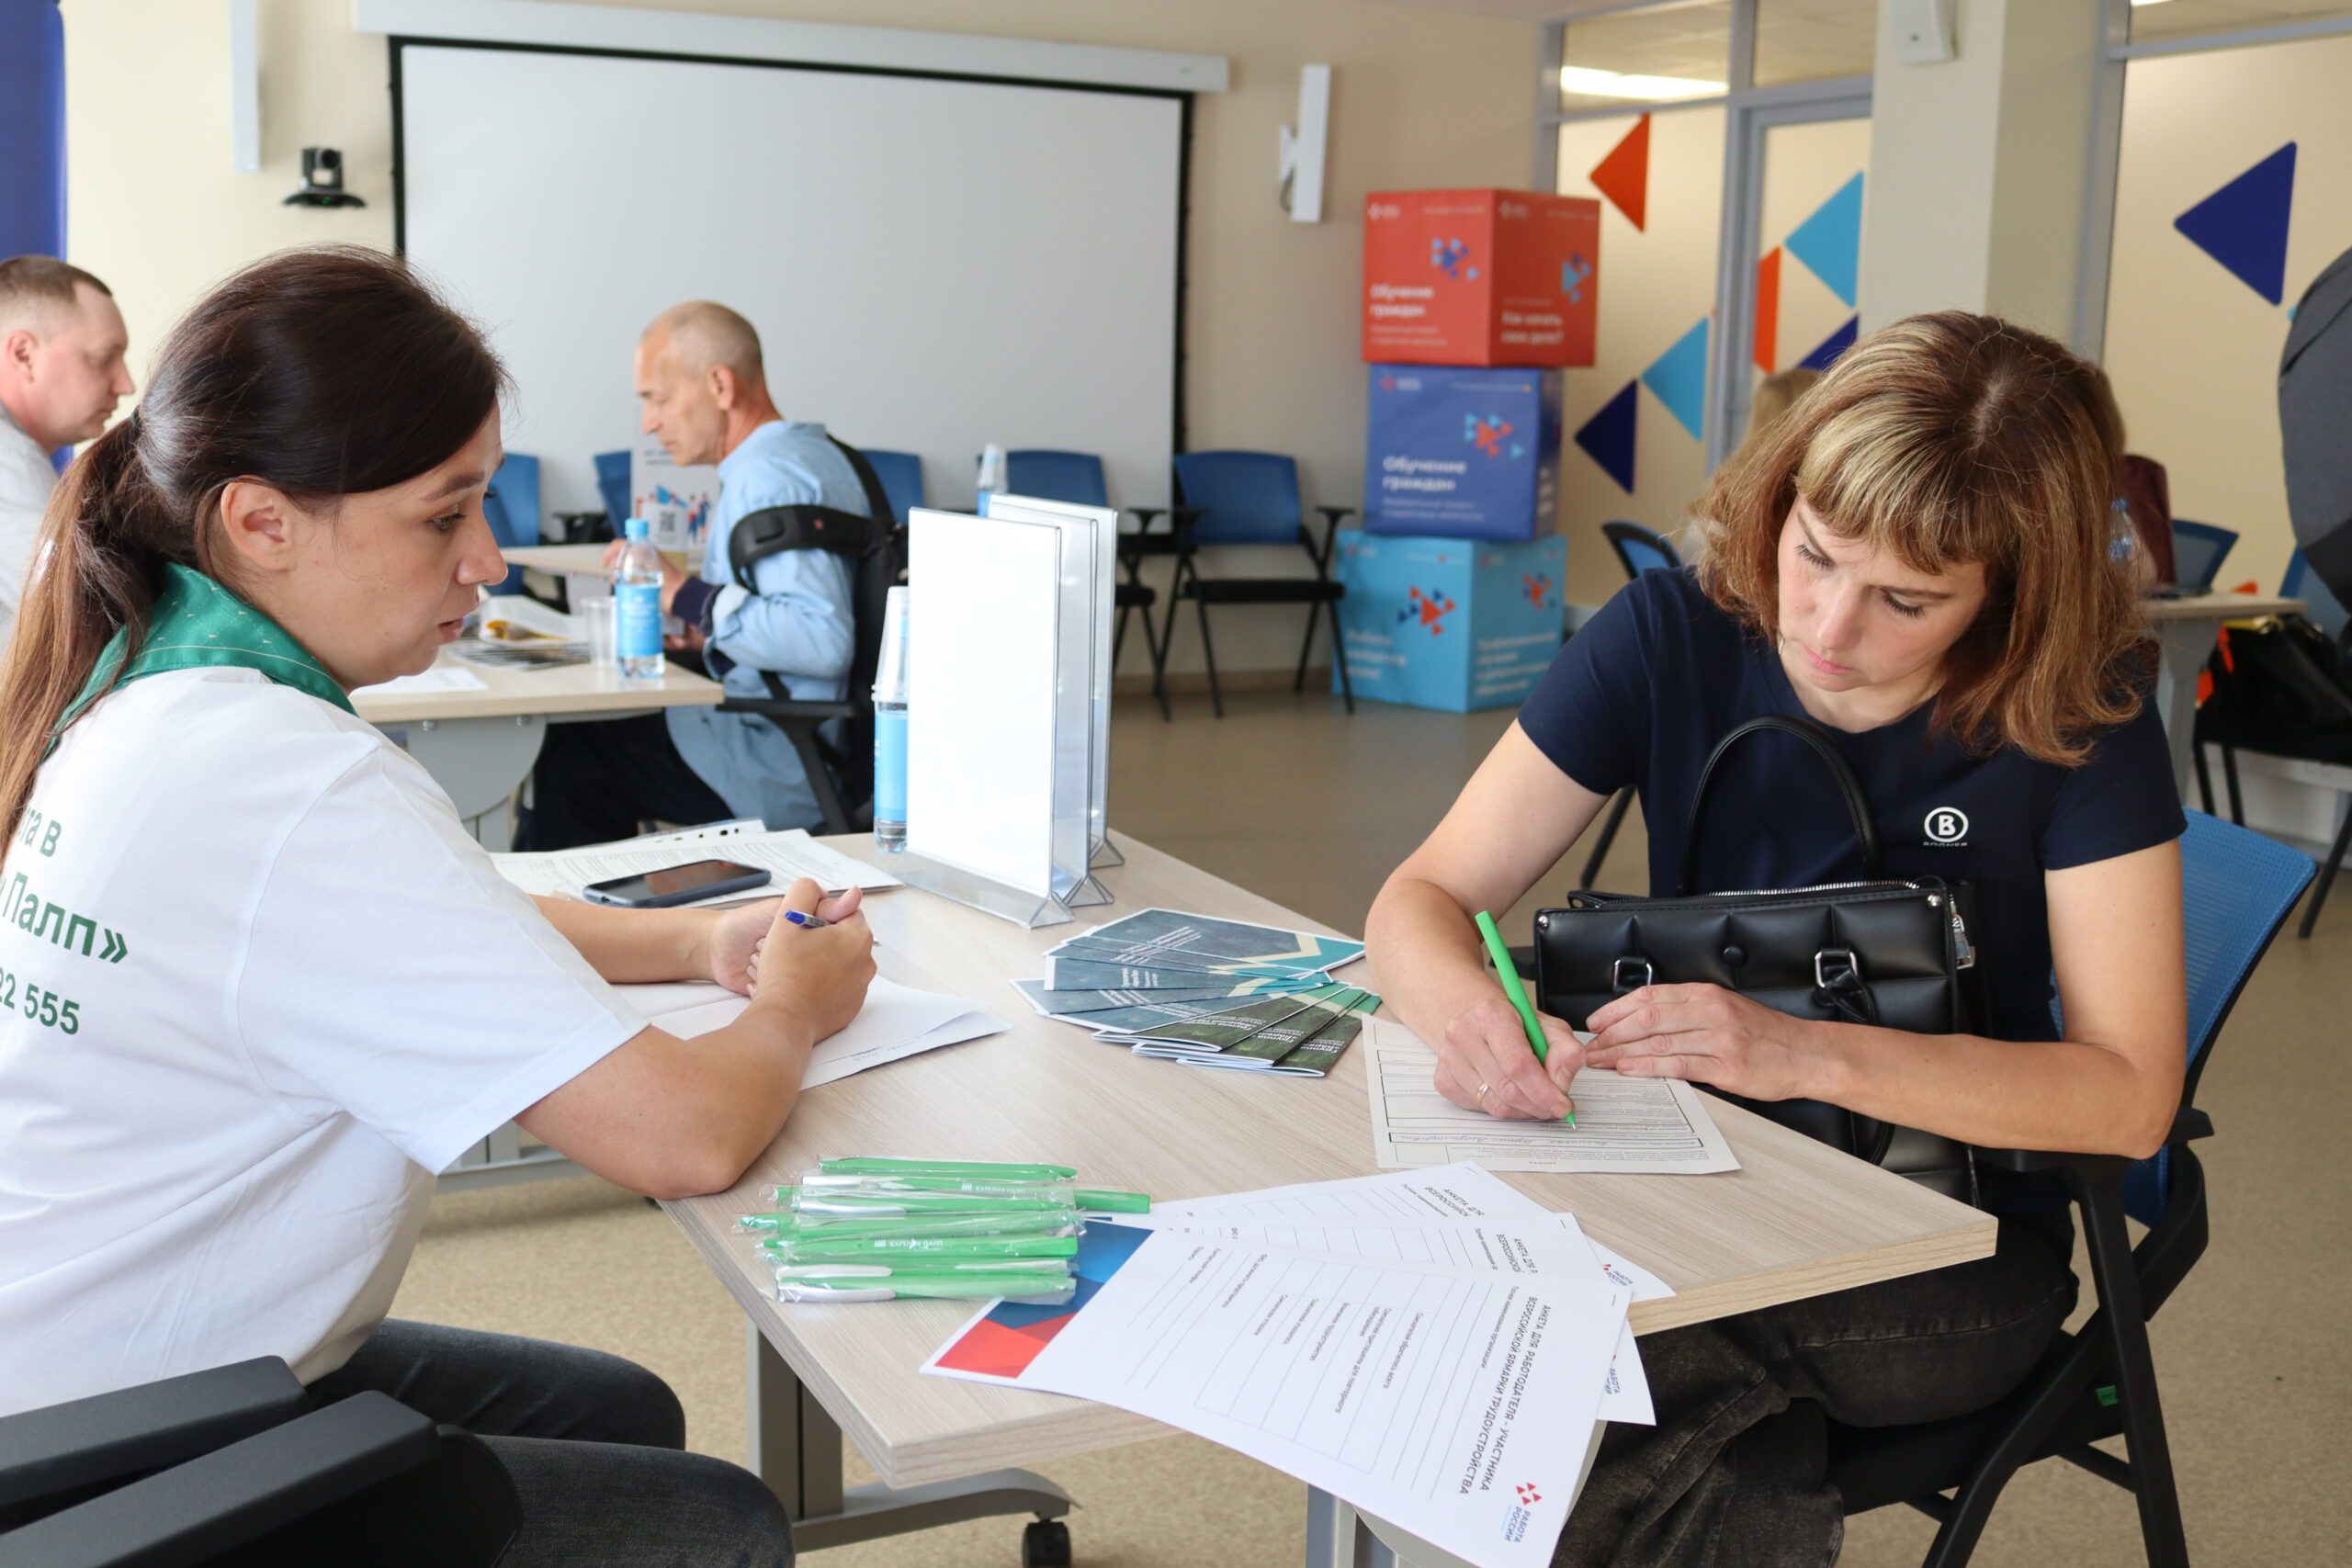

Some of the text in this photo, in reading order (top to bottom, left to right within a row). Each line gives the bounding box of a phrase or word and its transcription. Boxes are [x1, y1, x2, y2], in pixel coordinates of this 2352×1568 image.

[1383, 455, 1466, 475] Обучение
[1383, 476, 1455, 491] граждан
[2, 871, 128, 964] Палп»
[24, 983, 80, 1035] 555
[1442, 1190, 1469, 1210] АНКЕТА
[1513, 1238, 1529, 1257] АНКЕТА
[1494, 1300, 1510, 1333] наименование
[1535, 1304, 1551, 1332] АНКЕТА
[1480, 1333, 1498, 1369] организации
[1529, 1331, 1542, 1348] ДЛЯ
[1335, 1377, 1355, 1413] повторного
[1383, 1371, 1394, 1389] всего
[1459, 1296, 1538, 1494] ВСЕРОССИЙСКОЙ ЯРМАРКИ ТРУДОУСТРОЙСТВА
[1504, 1350, 1535, 1421] РАБОТОДАТЕЛЯ
[1479, 1427, 1510, 1491] УЧАСТНИКА
[1504, 1506, 1521, 1541] РОССИИ
[1513, 1510, 1531, 1542] РАБОТА
